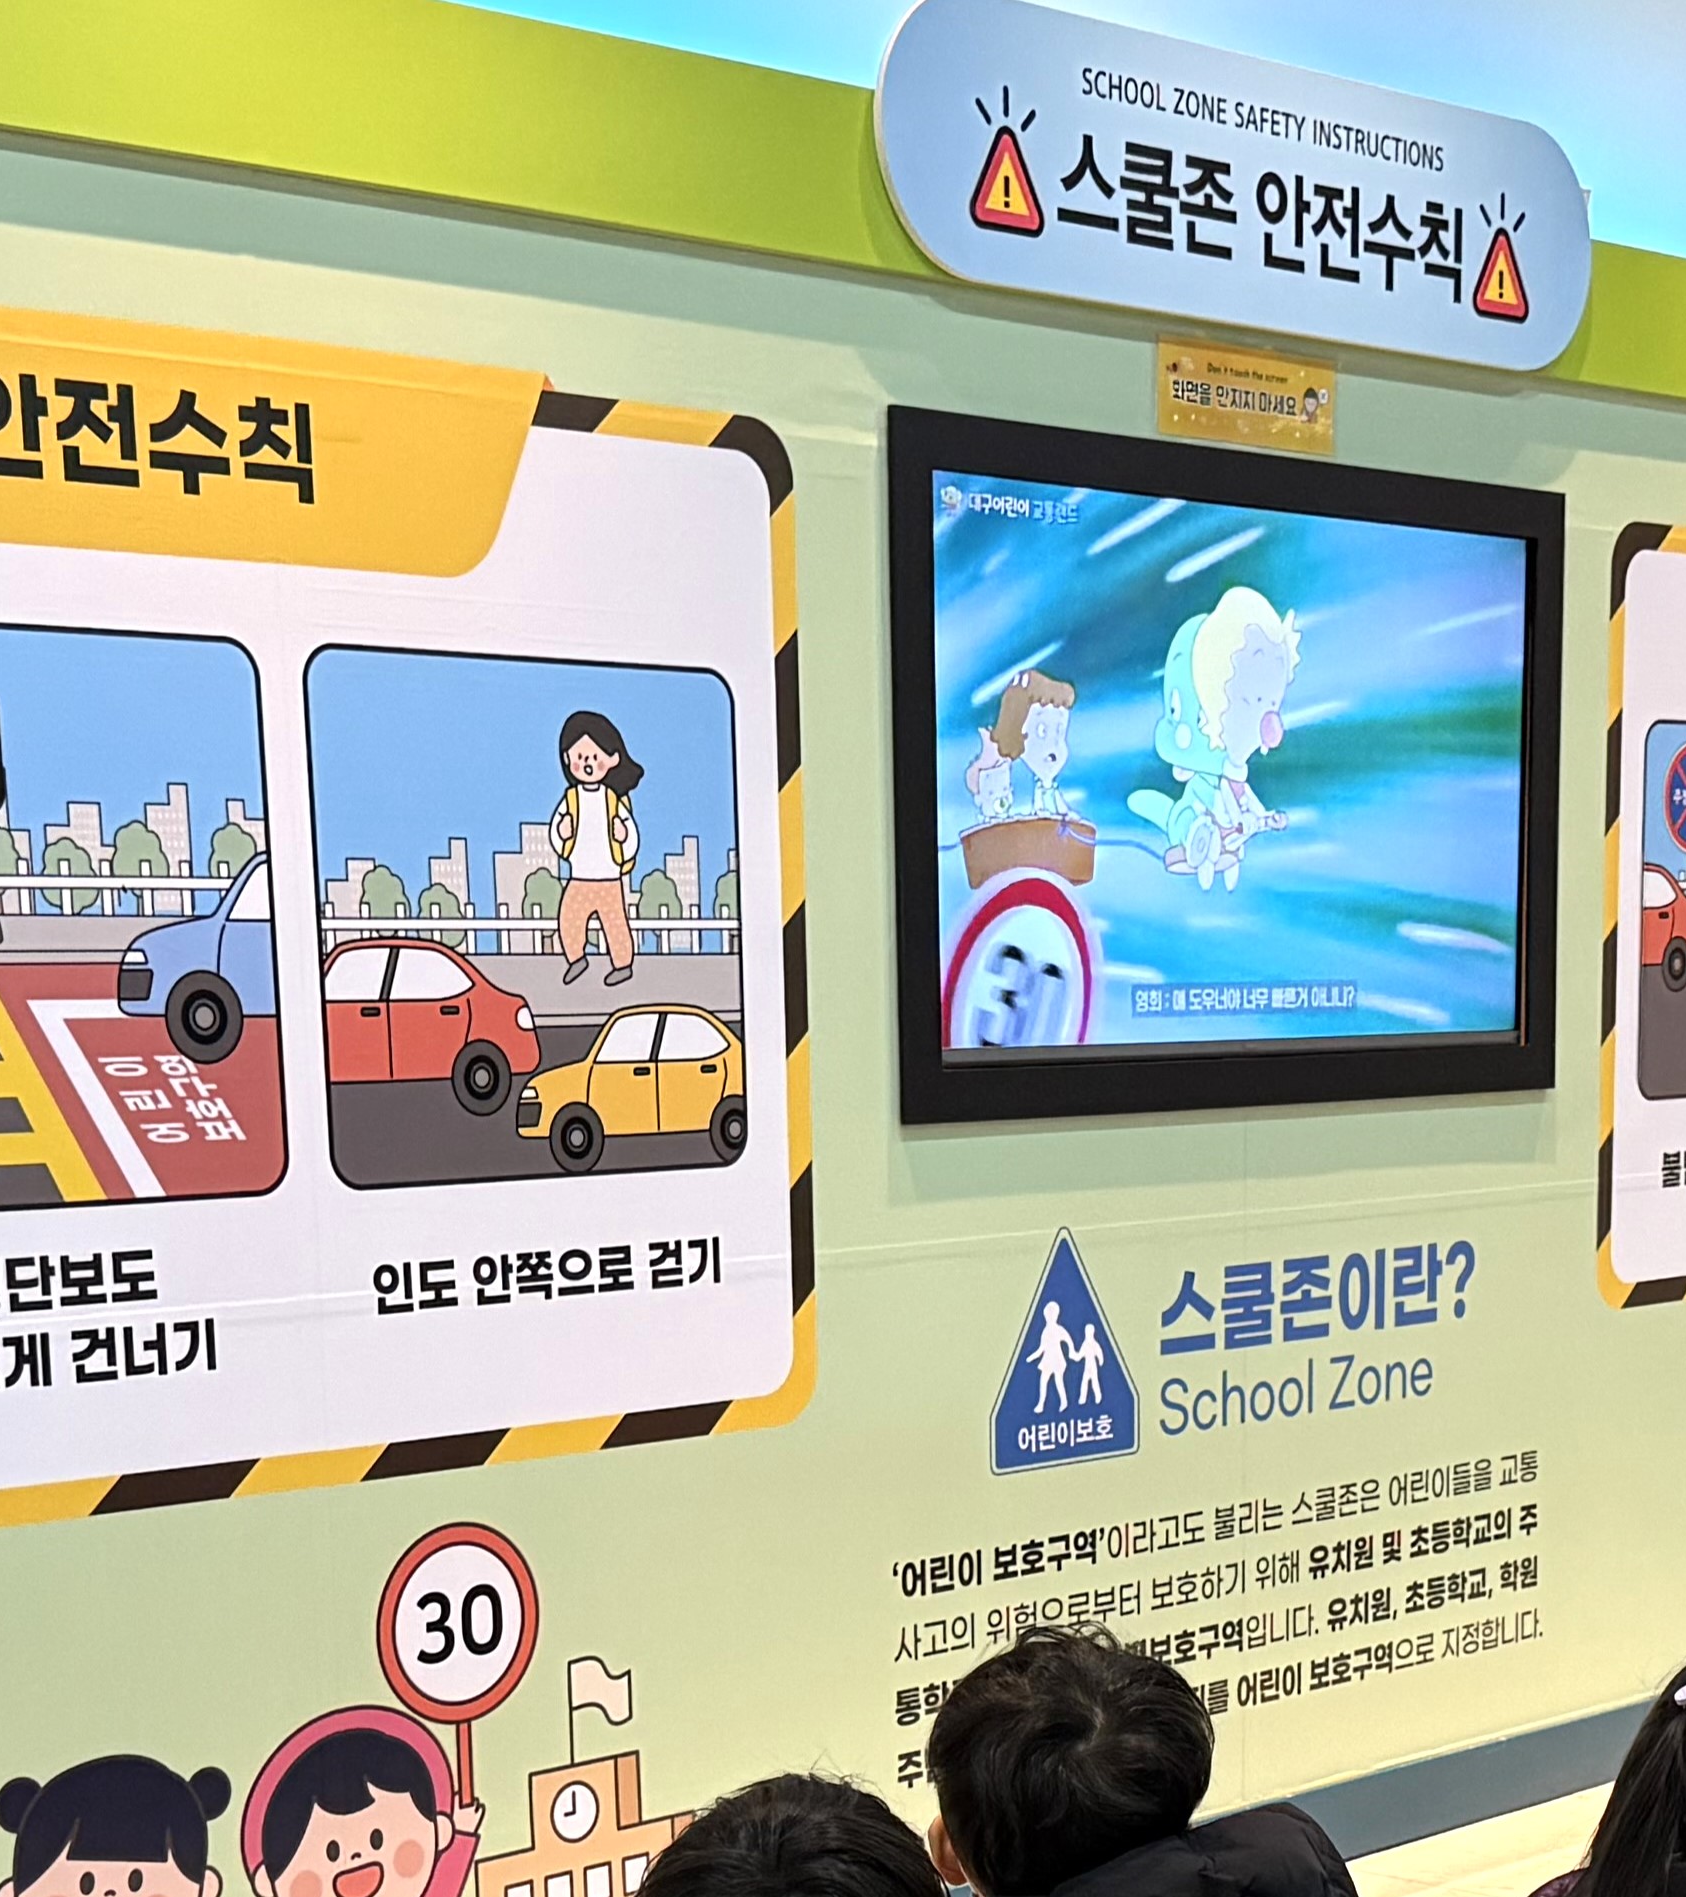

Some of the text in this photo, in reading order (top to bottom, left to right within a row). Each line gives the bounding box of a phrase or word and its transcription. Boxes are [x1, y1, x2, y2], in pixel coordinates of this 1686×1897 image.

[1081, 66, 1445, 173] SCHOOL ZONE SAFETY INSTRUCTIONS
[1057, 133, 1463, 304] 스쿨존 안전수칙
[1172, 379, 1297, 417] 화면을 만지지 마세요
[1243, 988, 1268, 1009] 너무
[372, 1236, 721, 1316] 인도 안쪽으로 걷기
[1160, 1240, 1476, 1356] 스쿨존이란?
[70, 1317, 217, 1384] 건너기
[1018, 1415, 1114, 1453] 어린이보호
[1159, 1354, 1433, 1436] School Zone
[1213, 1498, 1283, 1541] 불리는
[1291, 1479, 1381, 1525] 스쿨존은
[1388, 1458, 1492, 1506] 어린이들을
[1499, 1450, 1539, 1487] 교통
[894, 1612, 975, 1662] 사고의
[1151, 1560, 1246, 1611] 보호하기
[1255, 1550, 1300, 1590] 위해
[1308, 1535, 1374, 1580] 유치원
[1382, 1529, 1402, 1565] 및
[1410, 1507, 1512, 1560] 초등학교의
[1519, 1503, 1538, 1536] 주
[1327, 1587, 1397, 1632] 유치원,
[1404, 1567, 1493, 1615] 초등학교,
[1500, 1555, 1538, 1592] 학원
[415, 1583, 504, 1664] 30
[1236, 1662, 1302, 1708] 어린이
[1309, 1633, 1435, 1691] 보호구역으로
[1441, 1608, 1544, 1659] 지정합니다.
